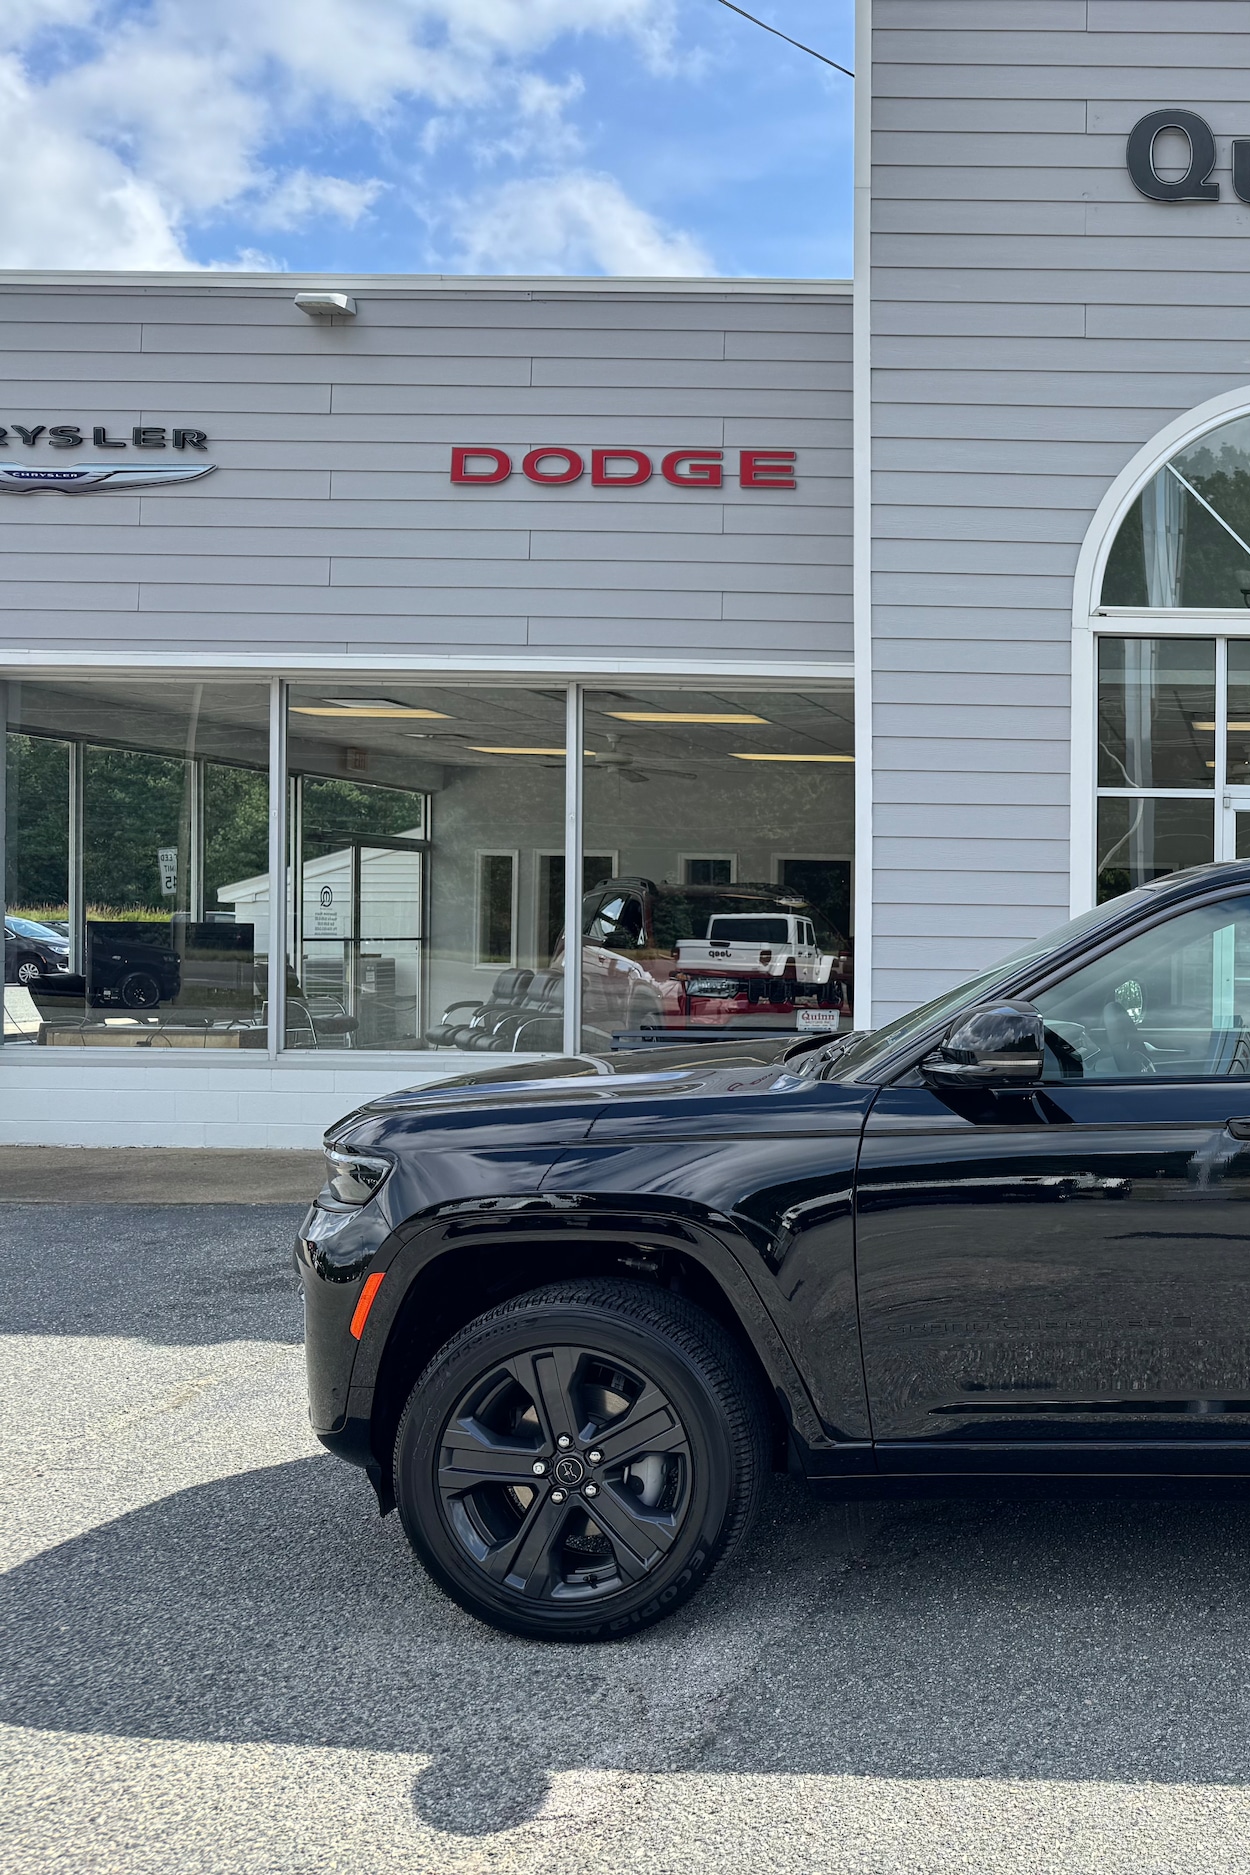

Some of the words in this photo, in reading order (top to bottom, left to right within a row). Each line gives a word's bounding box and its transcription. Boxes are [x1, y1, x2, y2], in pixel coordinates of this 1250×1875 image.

[0, 424, 208, 450] YSLER
[450, 447, 797, 489] DODGE
[802, 1012, 835, 1021] Quinn
